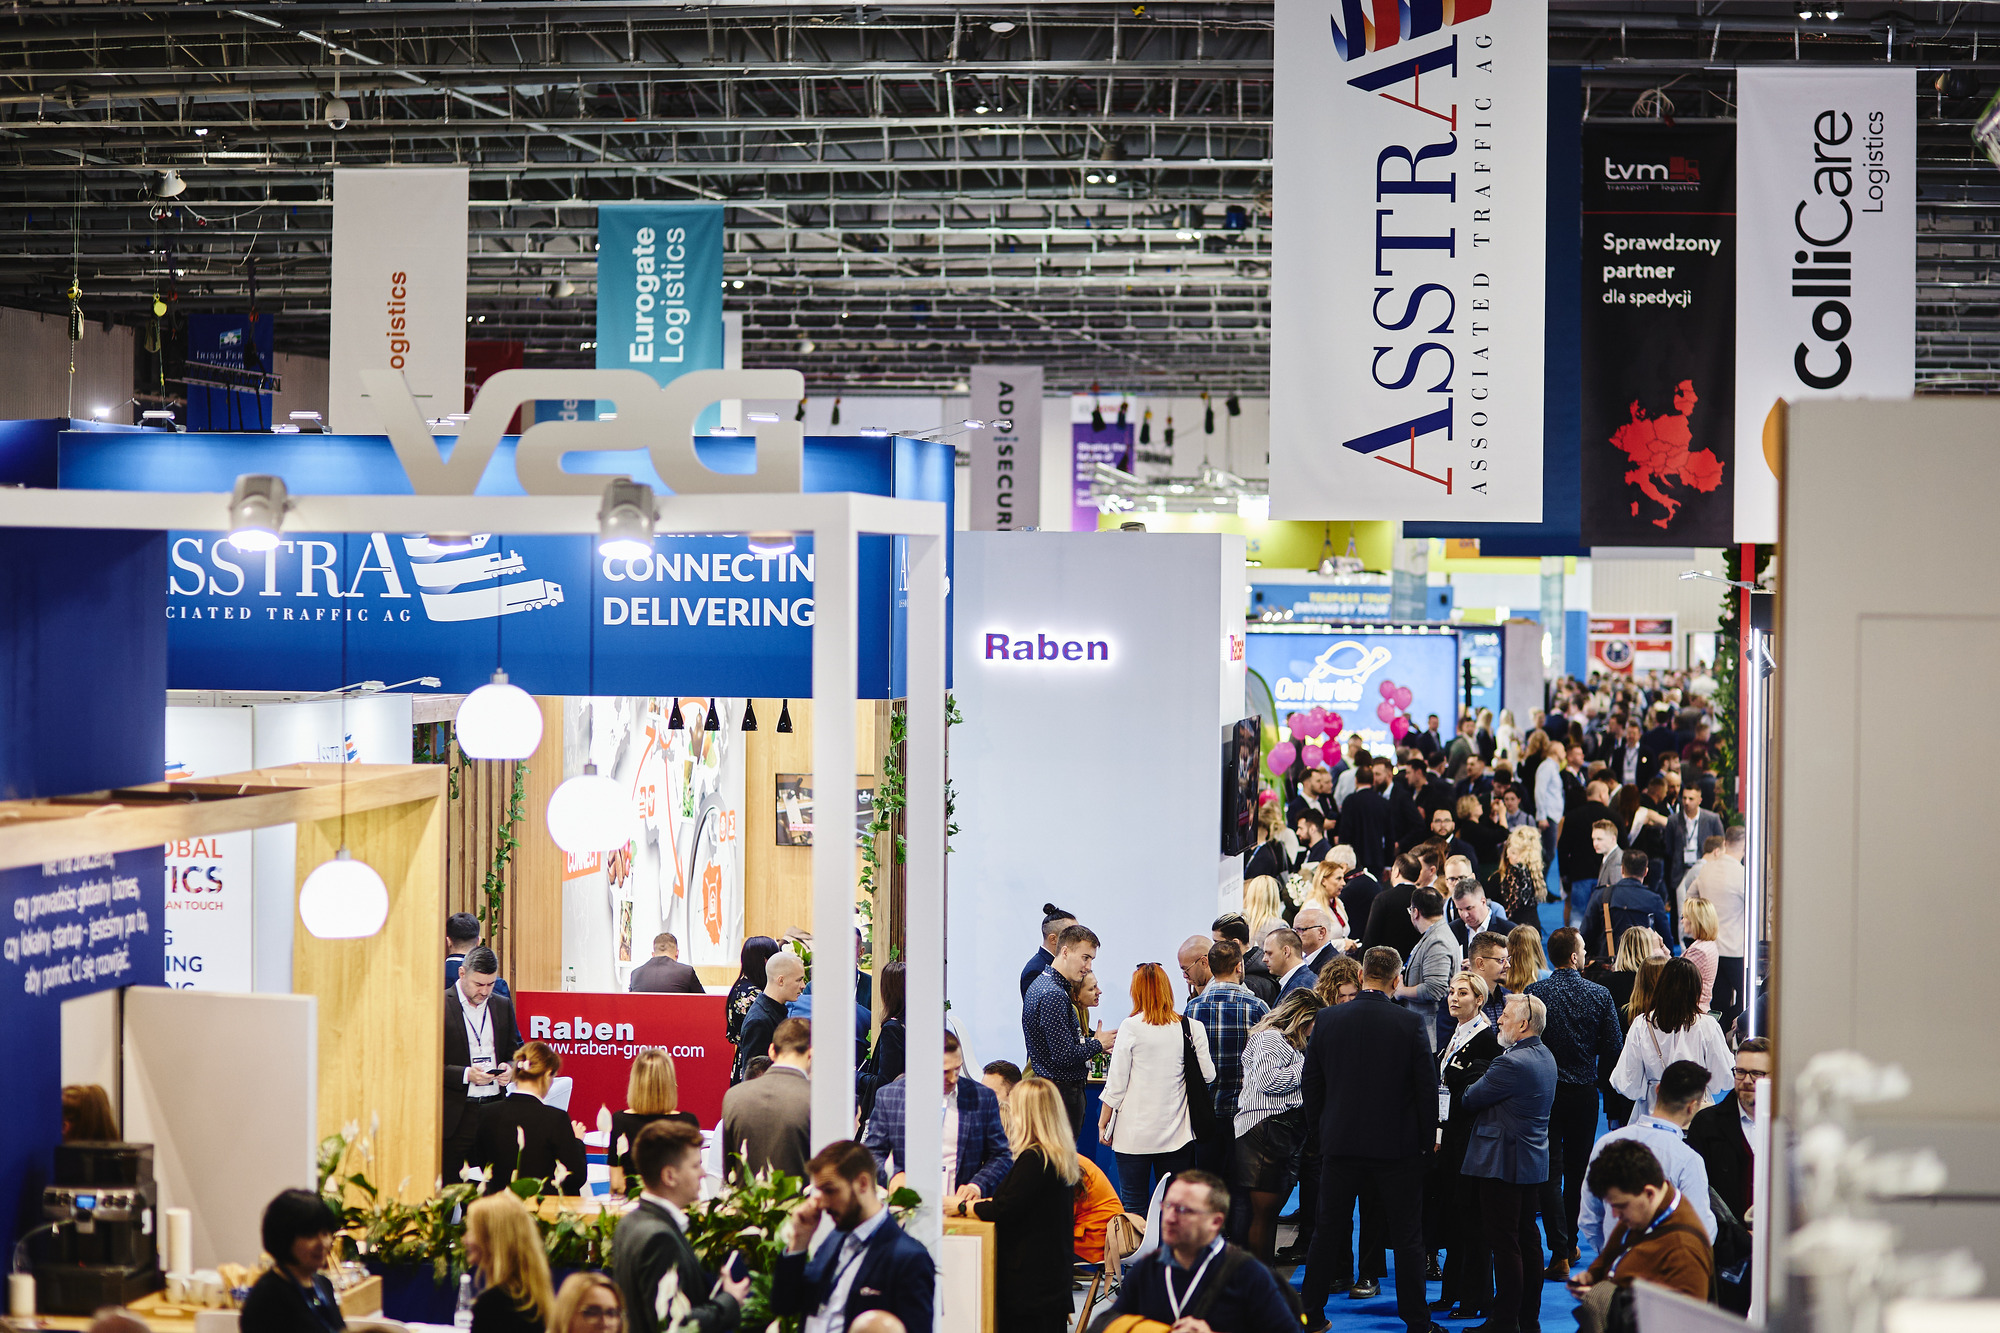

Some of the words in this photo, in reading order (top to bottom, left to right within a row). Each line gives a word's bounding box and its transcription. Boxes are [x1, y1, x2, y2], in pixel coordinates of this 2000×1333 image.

[1475, 34, 1493, 73] AG
[1473, 98, 1493, 247] TRAFFIC
[1605, 157, 1669, 180] tvm
[1862, 111, 1890, 212] Logistics
[1603, 232, 1722, 256] Sprawdzony
[1792, 110, 1853, 389] ColliCare
[1342, 34, 1458, 495] ASSTRA
[1602, 263, 1676, 283] partner
[629, 227, 661, 363] Eurogate
[659, 227, 691, 363] Logistics
[1602, 288, 1626, 304] dla
[1629, 288, 1692, 309] spedycji
[386, 271, 410, 371] ogistics
[1470, 273, 1490, 495] ASSOCIATED
[166, 532, 411, 599] SSTRA
[602, 553, 815, 582] CONNECTIN
[165, 606, 251, 620] CIATED
[266, 607, 368, 622] TRAFFIC
[384, 609, 411, 622] AG
[603, 597, 816, 627] DELIVERING
[985, 633, 1108, 661] Raben
[1274, 677, 1363, 702] OnTurtle
[185, 901, 223, 910] TOUCH
[530, 1015, 635, 1042] Raben
